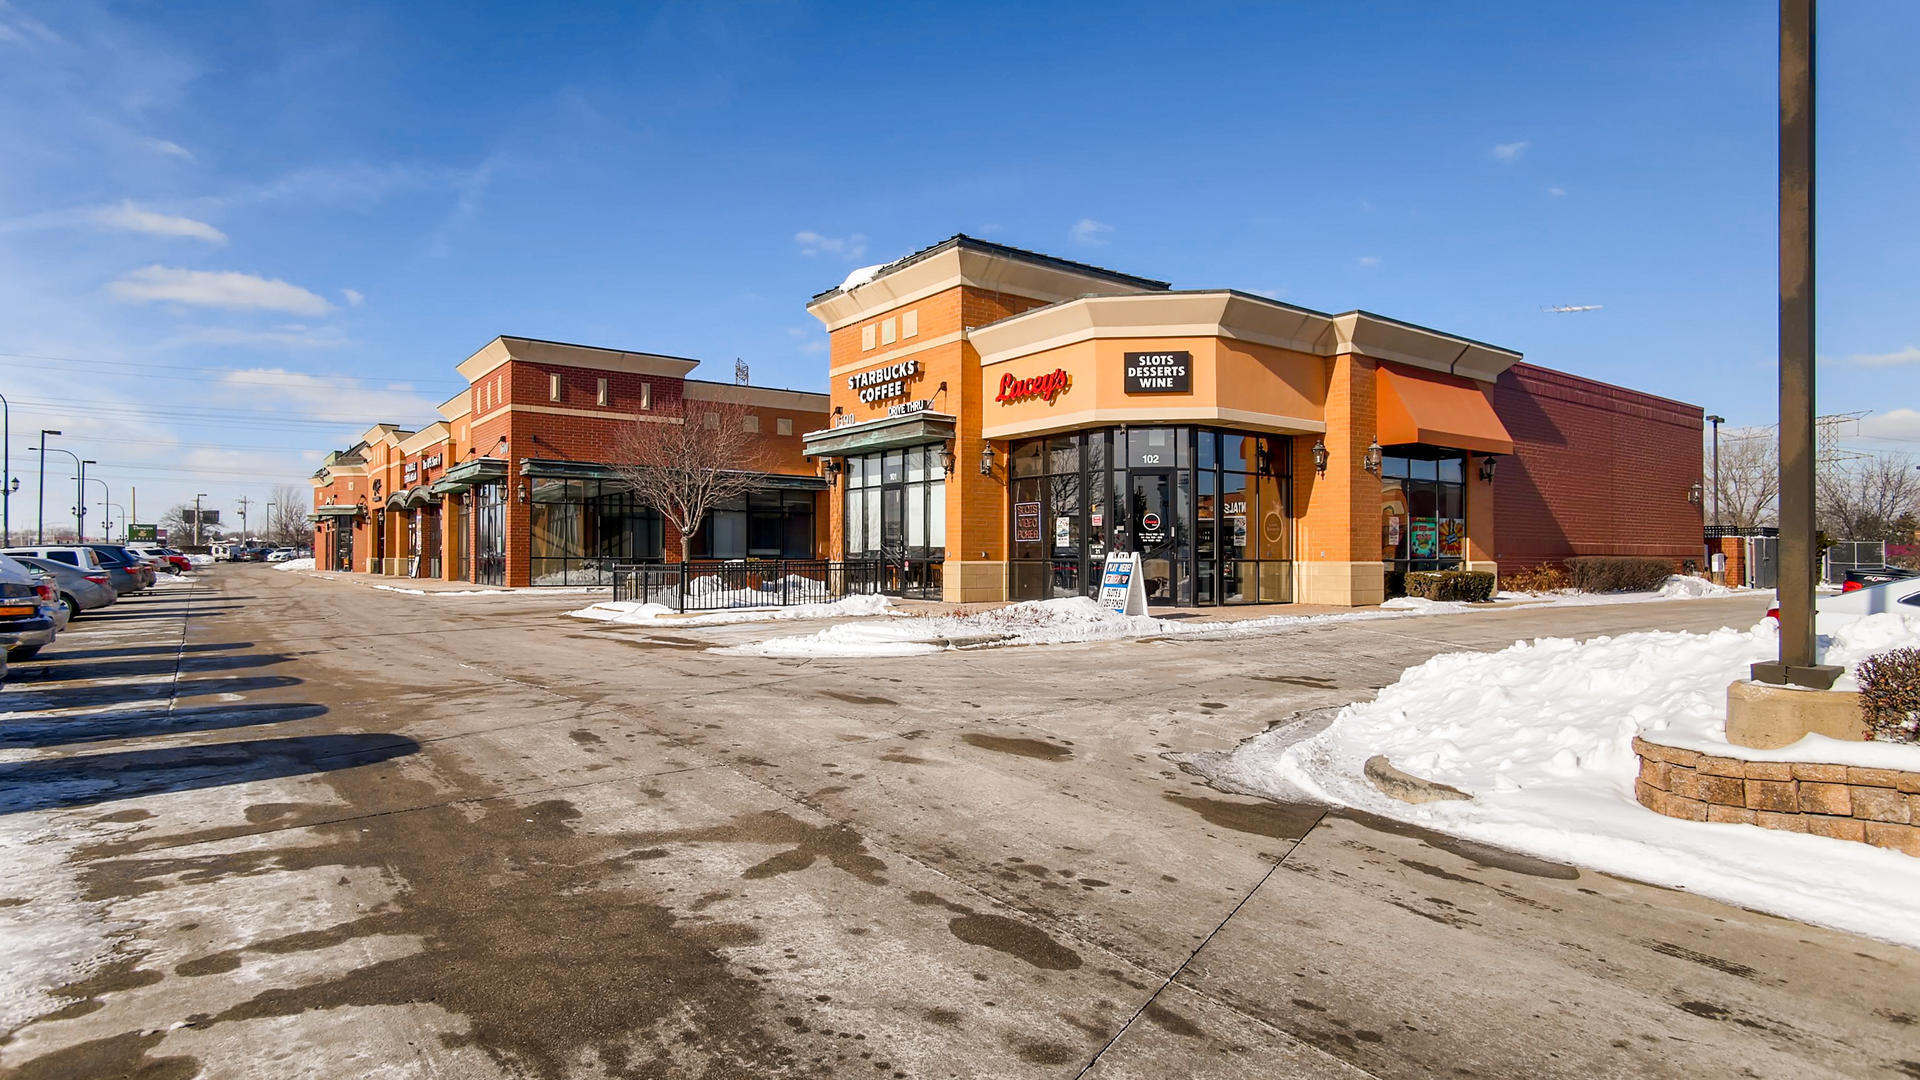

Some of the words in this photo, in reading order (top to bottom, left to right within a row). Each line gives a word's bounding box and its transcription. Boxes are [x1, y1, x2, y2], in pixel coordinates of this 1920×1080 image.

[1138, 355, 1174, 365] SLOTS
[848, 360, 916, 390] STARBUCKS
[1127, 366, 1186, 377] DESSERTS
[995, 368, 1067, 401] Lacey's
[1139, 377, 1174, 388] WINE
[860, 381, 903, 404] COFFEE
[888, 403, 906, 416] DRIVE
[906, 400, 925, 412] THRU
[1142, 454, 1160, 464] 102
[1017, 505, 1038, 514] SLOTS
[1018, 517, 1038, 528] VIDEO
[1017, 530, 1039, 539] POKER
[1107, 563, 1119, 573] PLAY
[1106, 588, 1118, 598] SLOTS
